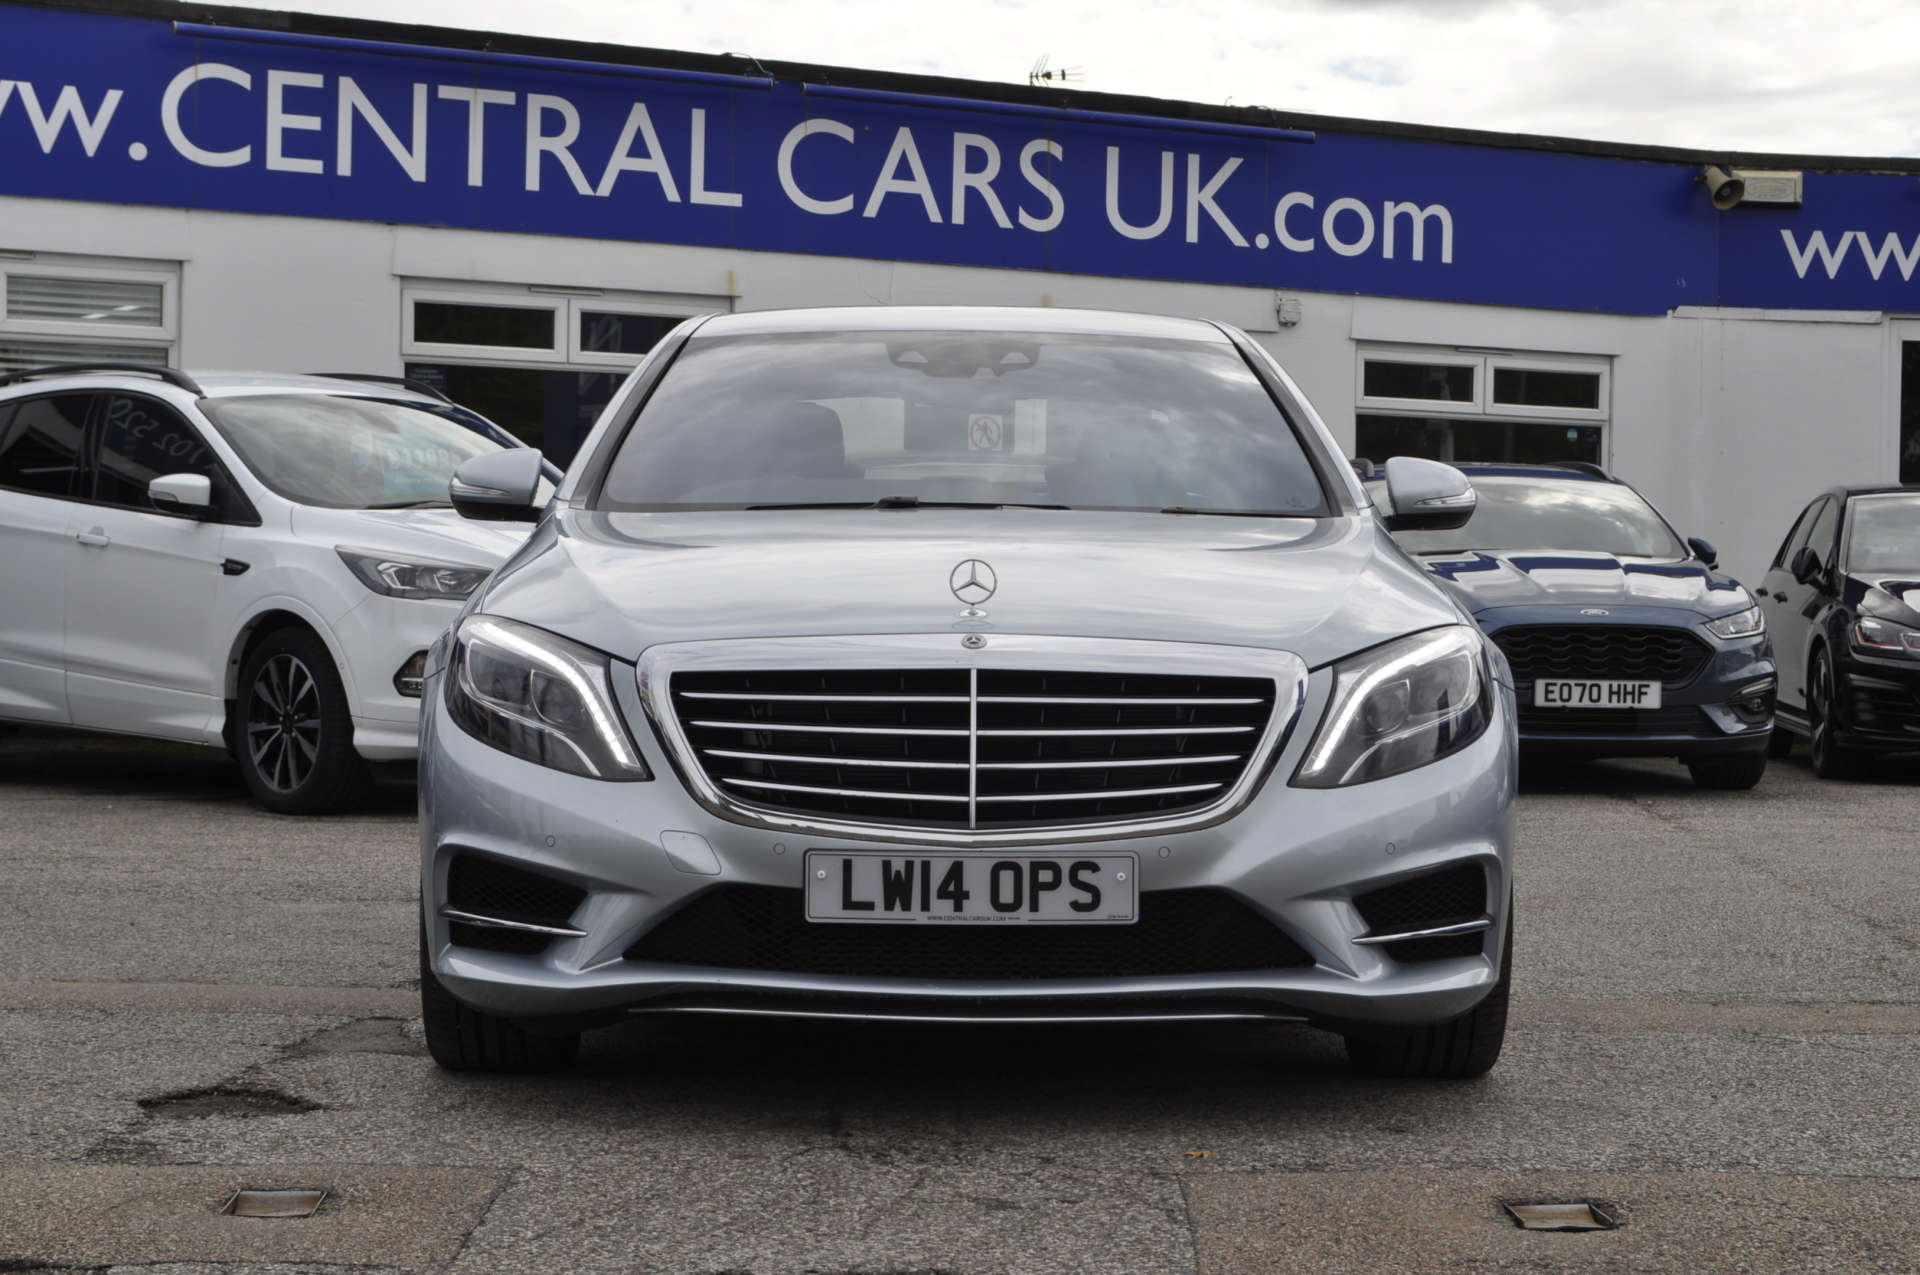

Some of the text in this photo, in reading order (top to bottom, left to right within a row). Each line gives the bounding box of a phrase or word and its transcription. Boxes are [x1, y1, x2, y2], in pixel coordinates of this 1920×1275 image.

[777, 118, 1064, 232] CARS
[1106, 145, 1453, 264] UK.com
[1608, 684, 1650, 704] HHF
[842, 858, 1102, 913] LW14 OPS
